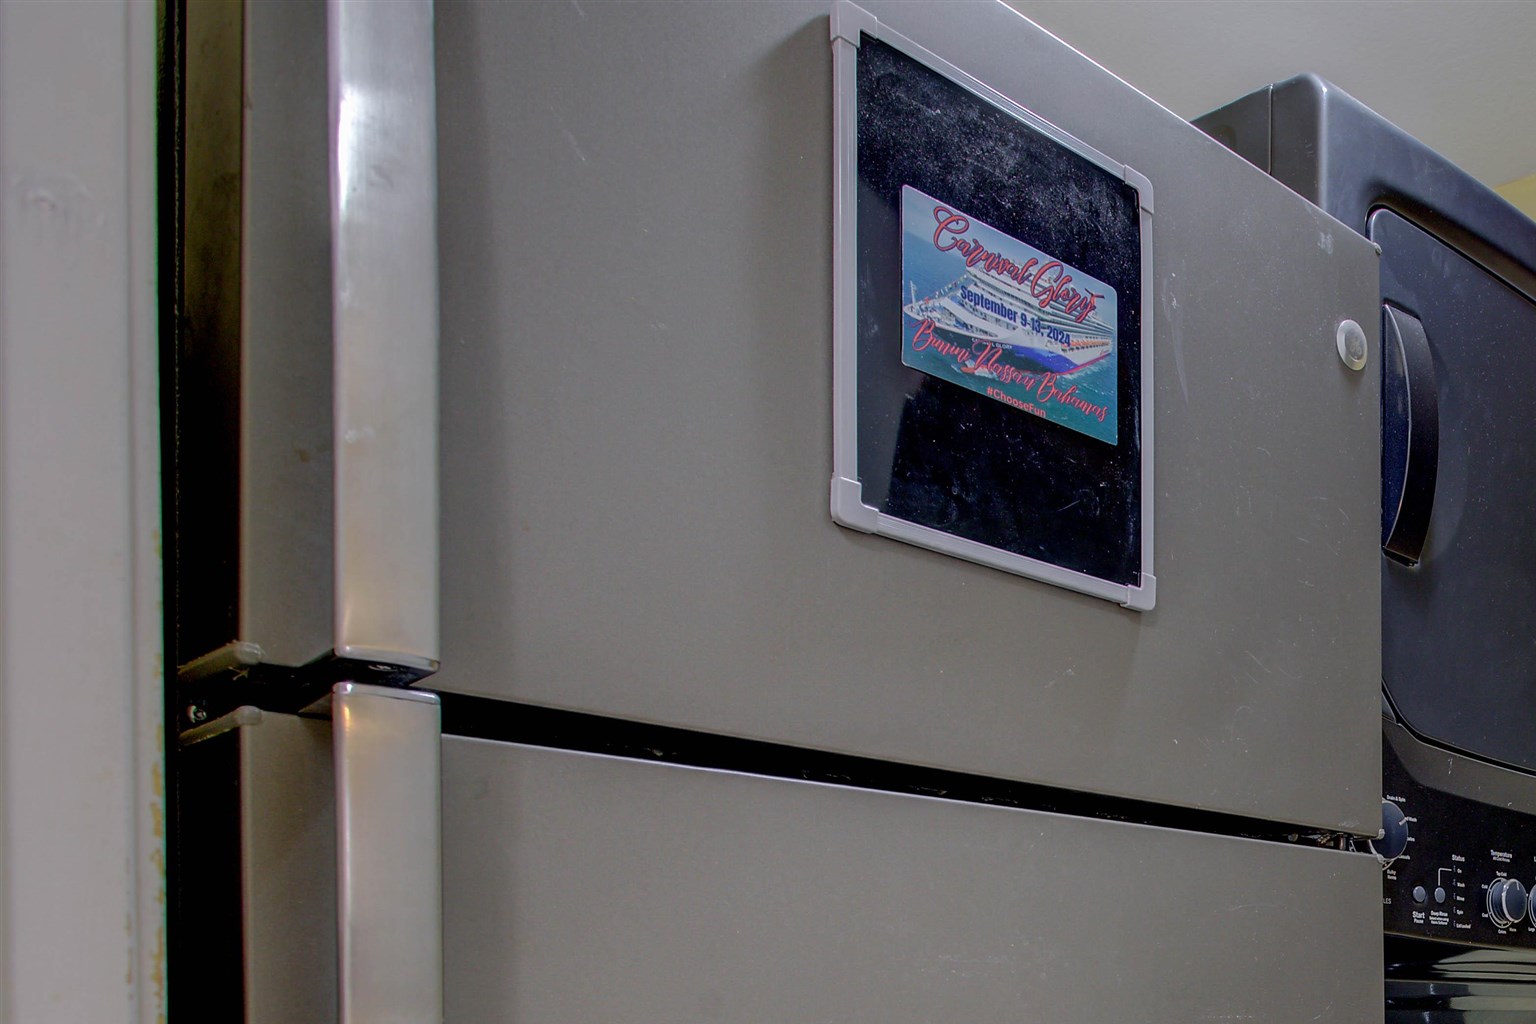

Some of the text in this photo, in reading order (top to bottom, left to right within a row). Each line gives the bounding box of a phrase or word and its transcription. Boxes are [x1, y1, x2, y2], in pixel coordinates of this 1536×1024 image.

[933, 205, 1104, 323] Carnival Glory
[960, 284, 1018, 323] September
[1046, 325, 1071, 347] 2024
[972, 340, 1037, 391] Nassau
[1036, 371, 1108, 422] Bahamas
[986, 386, 1047, 418] #ChooseFun
[1451, 853, 1466, 862] Status
[1412, 911, 1426, 919] Start
